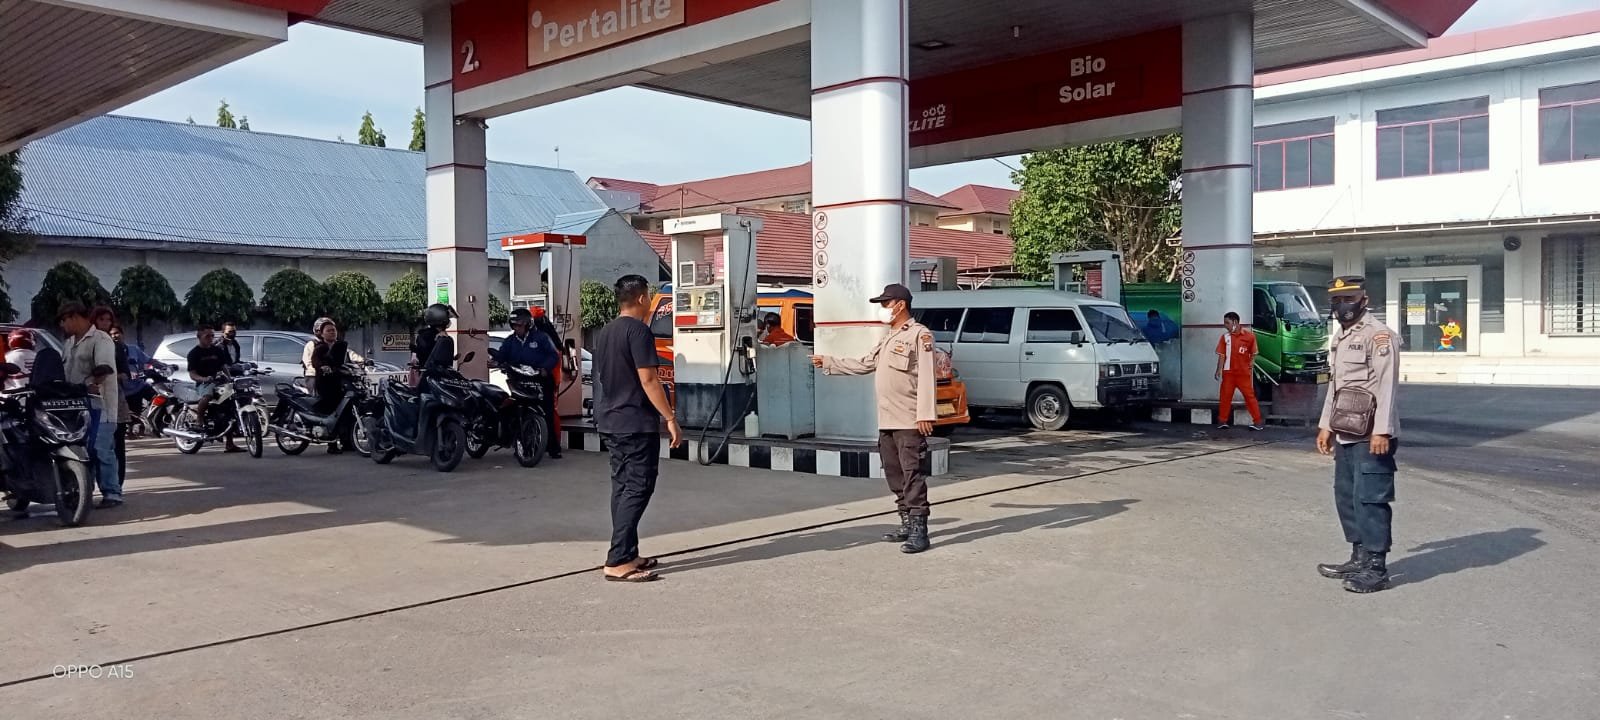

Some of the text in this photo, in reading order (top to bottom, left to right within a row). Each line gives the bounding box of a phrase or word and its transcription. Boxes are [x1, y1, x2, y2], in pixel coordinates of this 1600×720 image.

[543, 0, 671, 51] Pertalite
[461, 40, 480, 74] 2.
[1070, 56, 1106, 77] Bio
[1059, 81, 1116, 103] Solar
